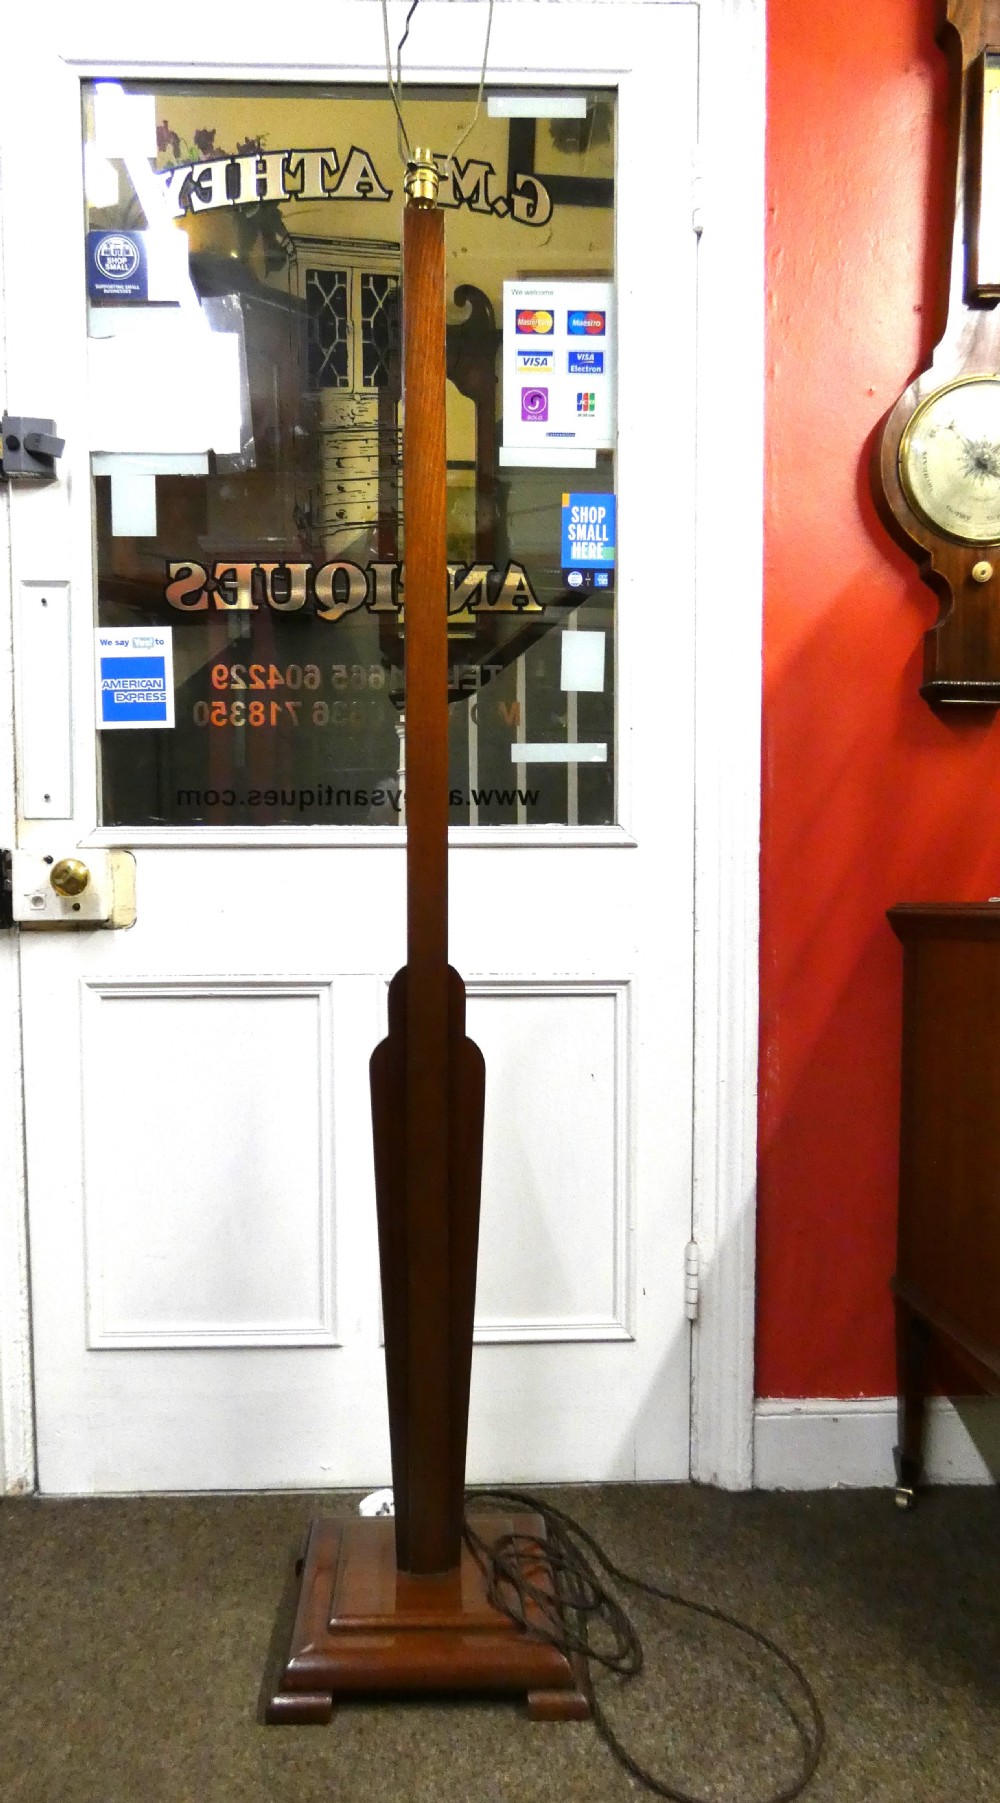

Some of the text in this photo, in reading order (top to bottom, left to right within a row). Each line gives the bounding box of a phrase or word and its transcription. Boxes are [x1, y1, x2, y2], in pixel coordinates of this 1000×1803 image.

[572, 319, 601, 327] Maestro
[577, 353, 595, 361] VISA
[523, 357, 548, 366] VISA
[572, 506, 605, 523] SHOP
[568, 524, 608, 541] SMALL
[572, 542, 603, 559] HERE
[102, 680, 161, 688] AMERICAN
[116, 693, 166, 701] EXPRESS
